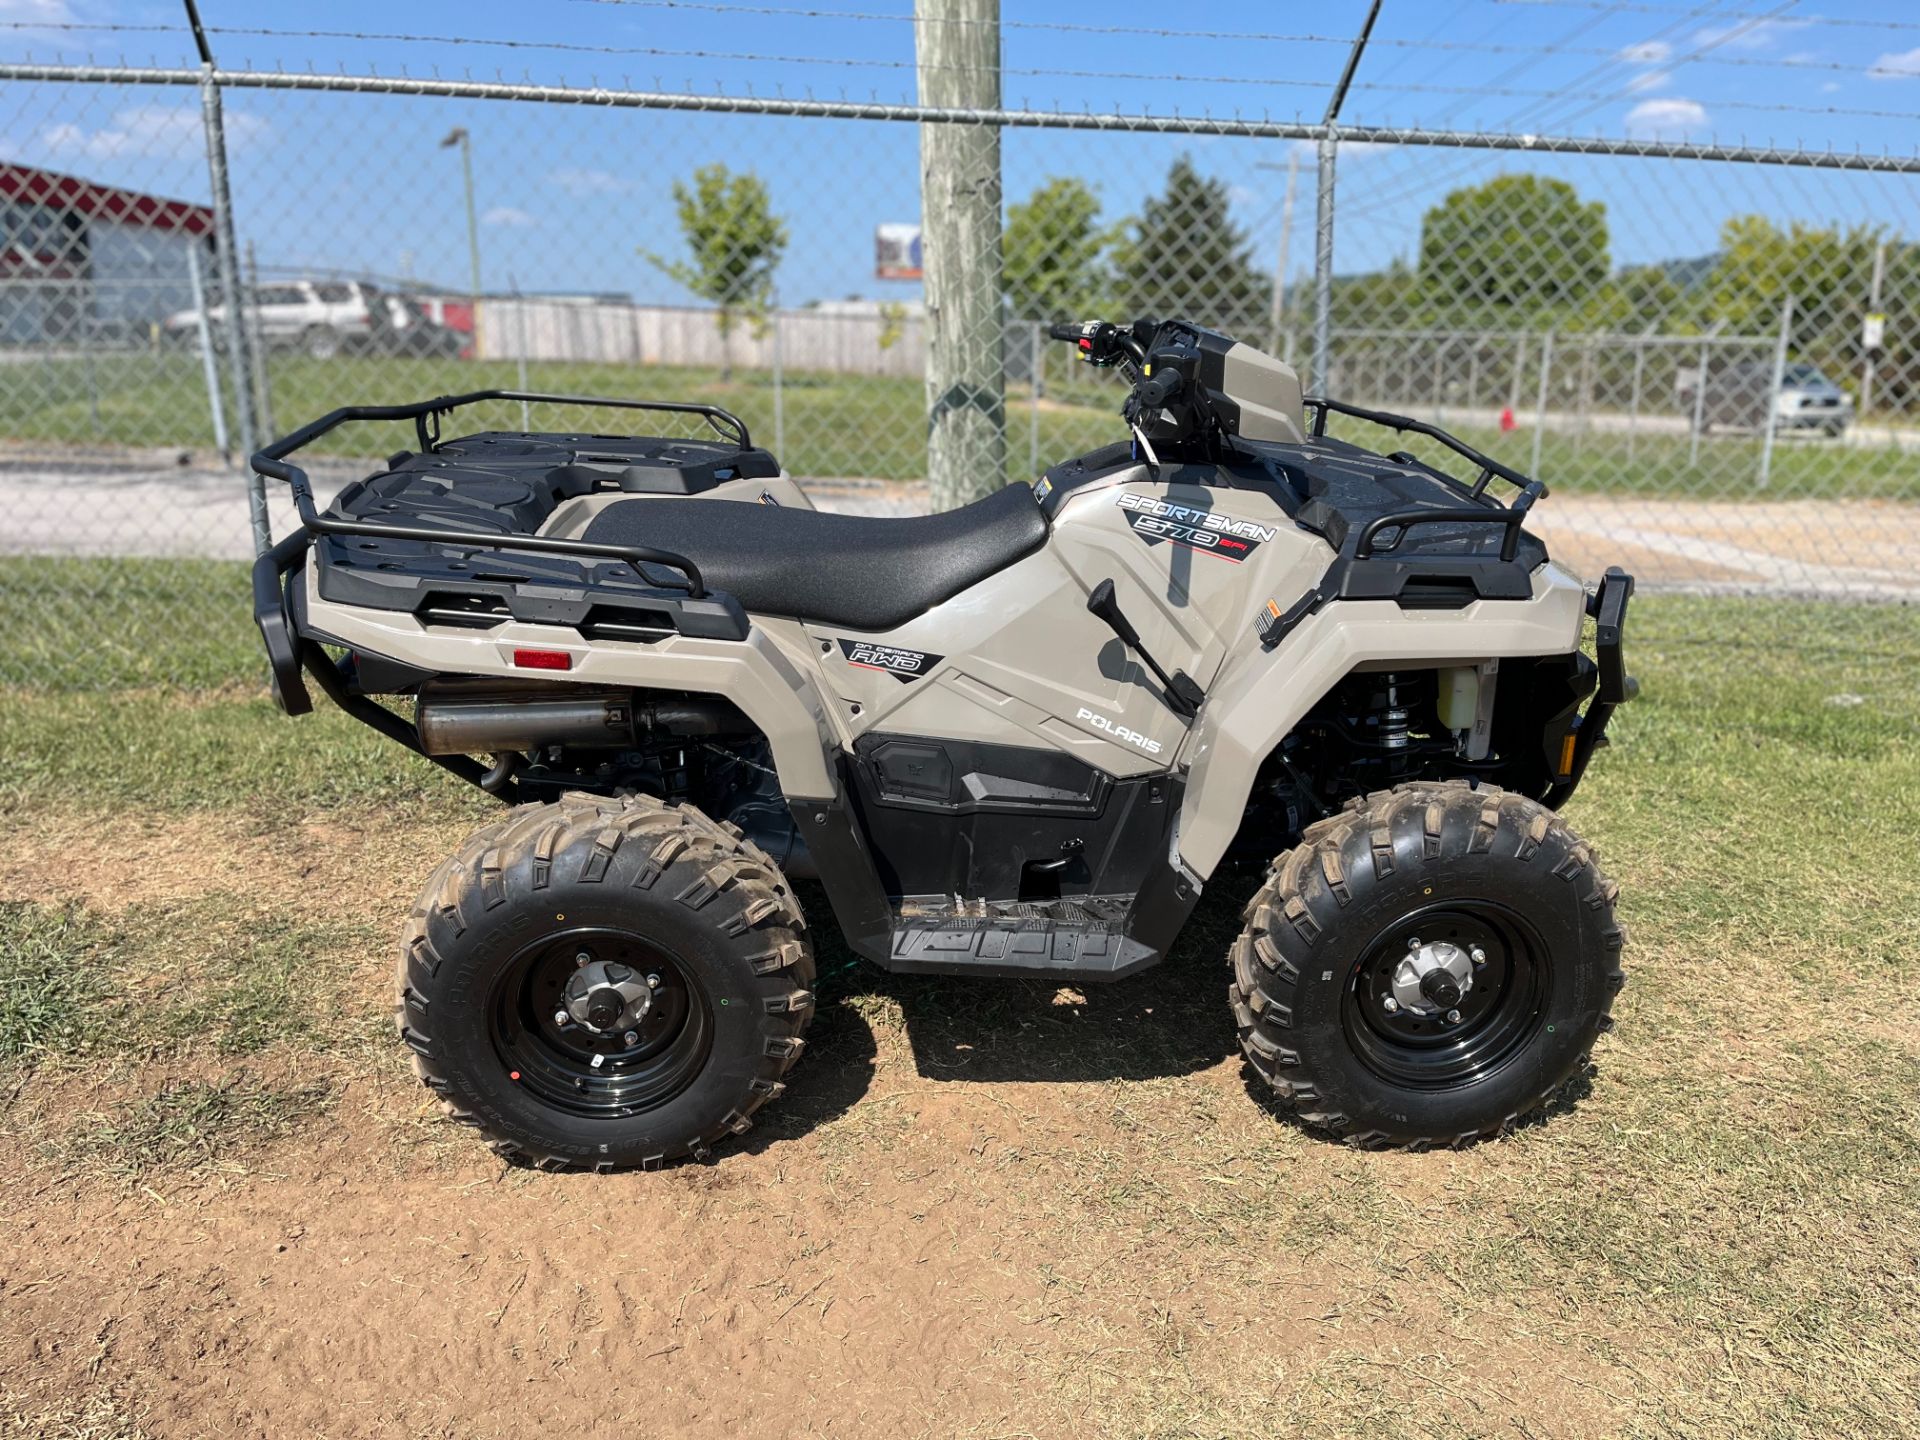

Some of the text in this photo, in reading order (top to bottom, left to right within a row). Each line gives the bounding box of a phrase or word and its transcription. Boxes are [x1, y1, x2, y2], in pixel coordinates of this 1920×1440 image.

[1117, 493, 1278, 543] SPORTSMAN
[1133, 514, 1249, 552] 570 EFI
[849, 648, 921, 671] AWD
[855, 643, 924, 659] ON DEMAND
[1076, 707, 1163, 754] POLARIS
[448, 911, 530, 1004] POLARIS
